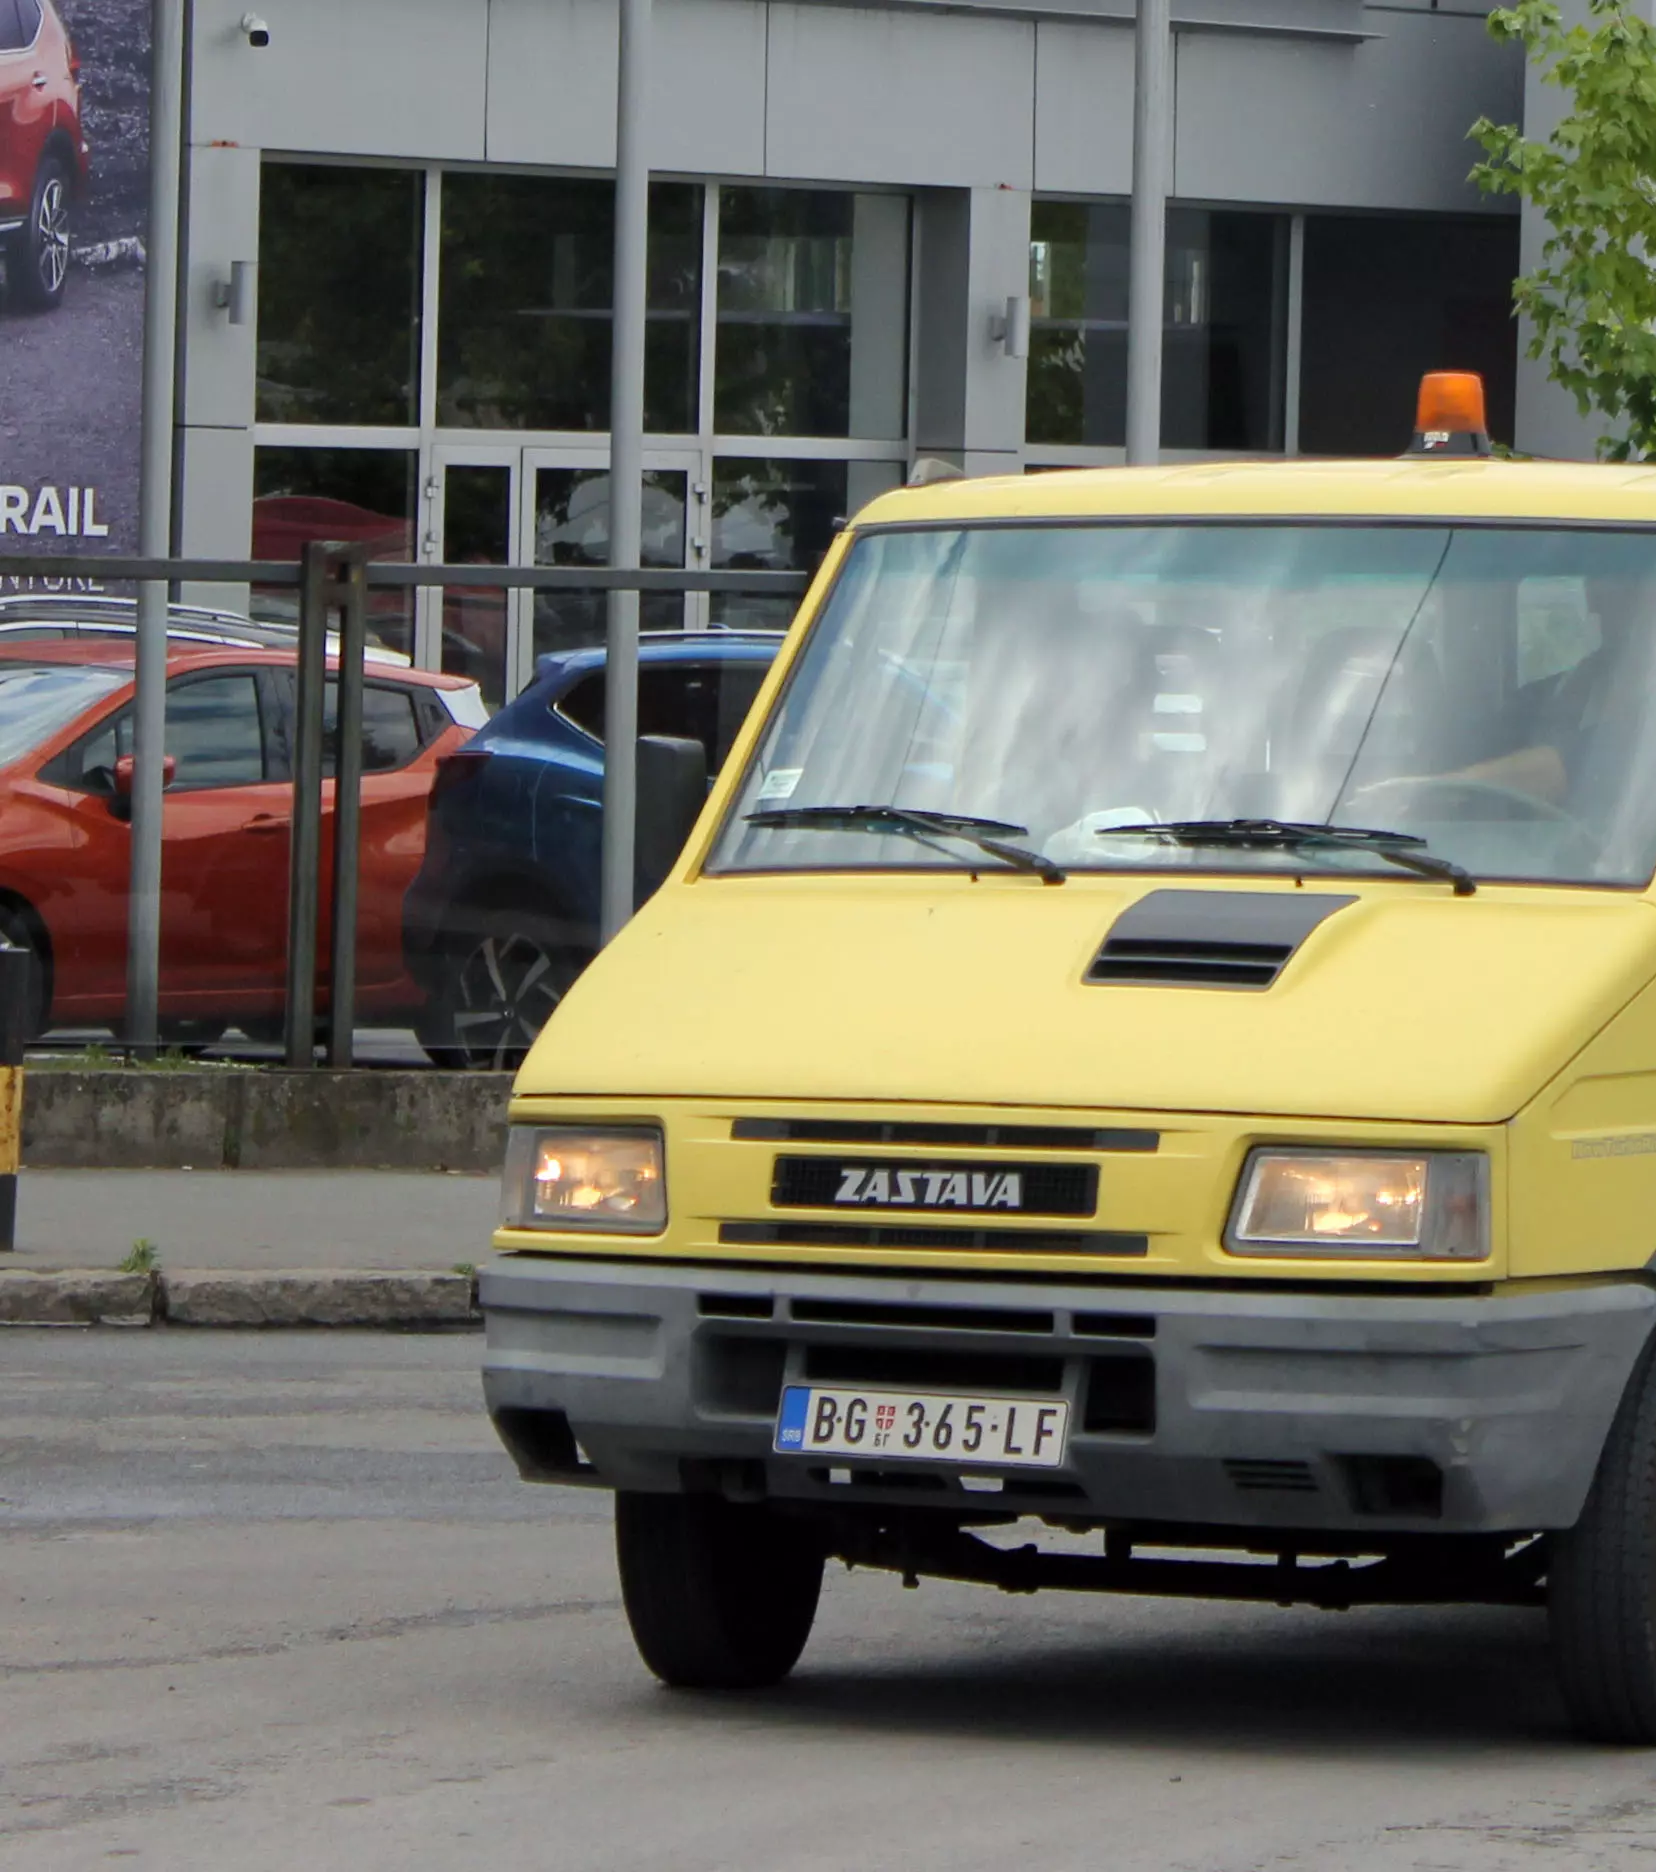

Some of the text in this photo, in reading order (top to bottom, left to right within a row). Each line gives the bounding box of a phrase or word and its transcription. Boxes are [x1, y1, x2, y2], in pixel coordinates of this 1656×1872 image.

[0, 485, 109, 537] RAIL
[835, 1168, 1022, 1207] ZASTAVA
[812, 1396, 867, 1445] BG
